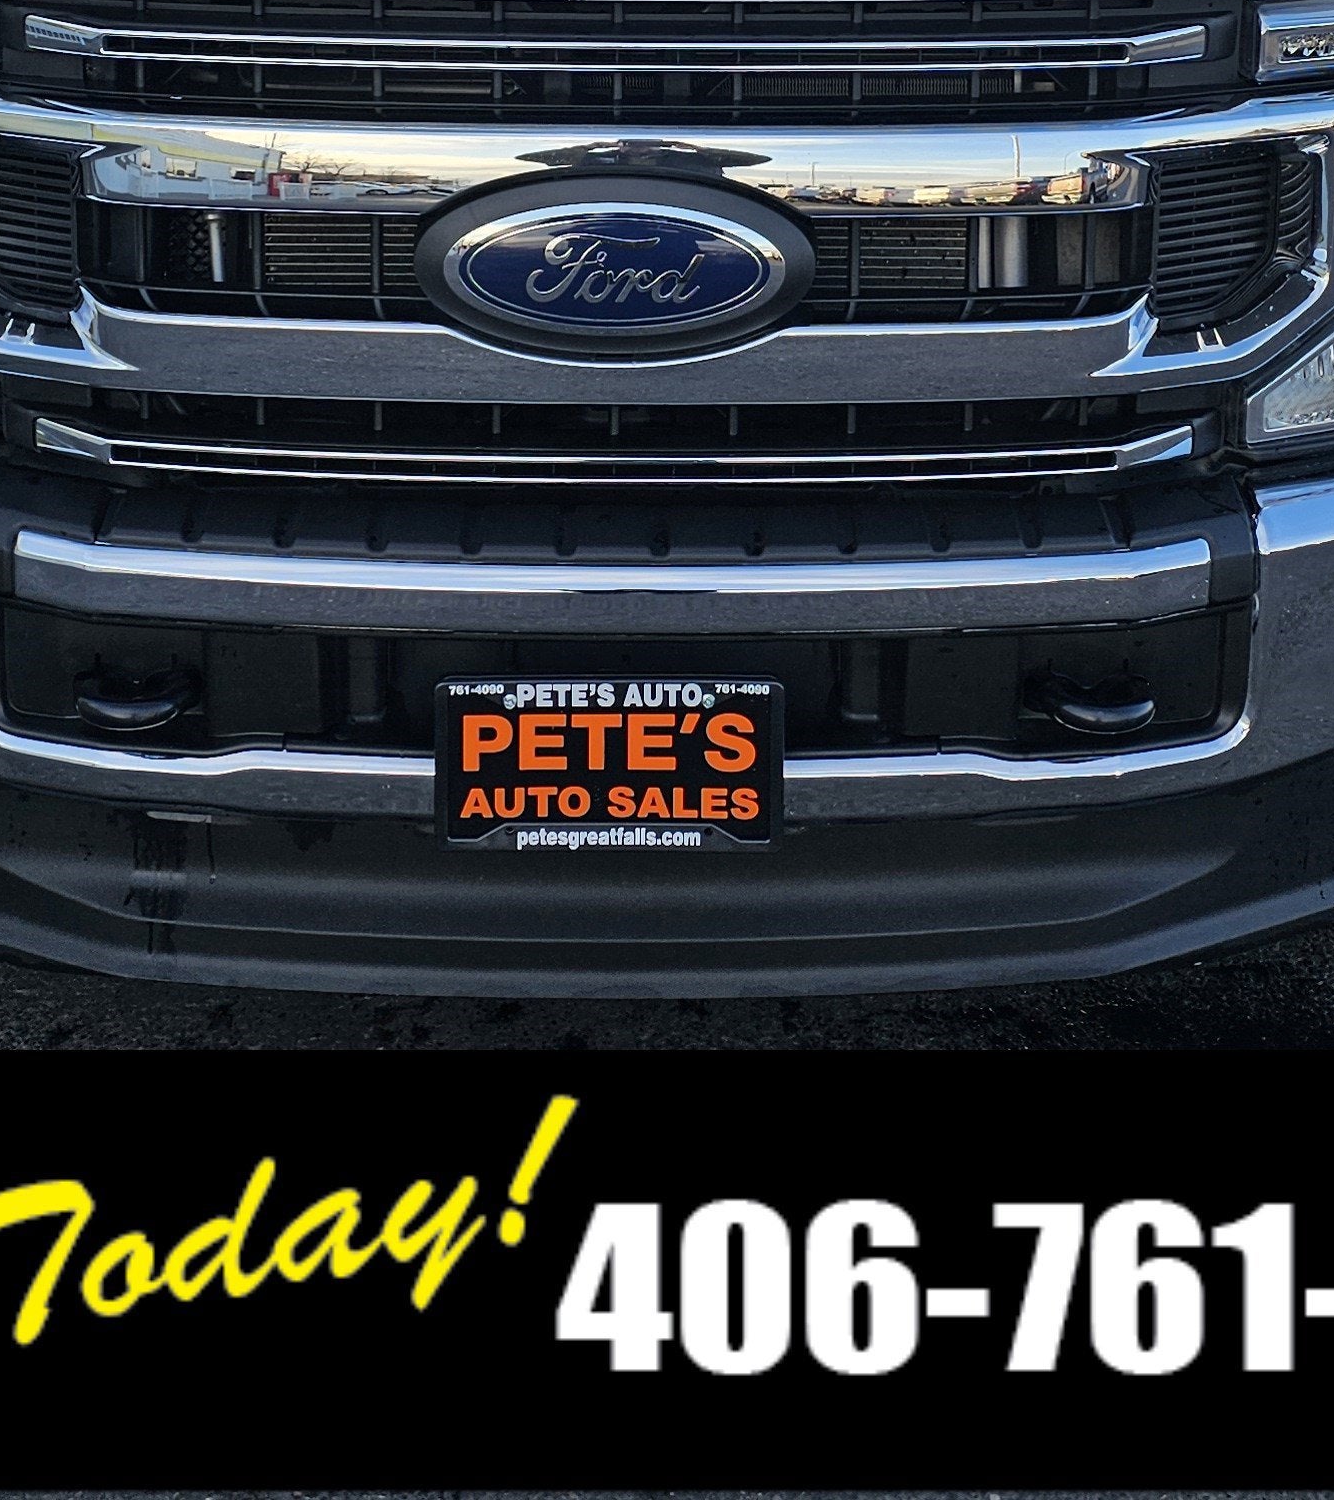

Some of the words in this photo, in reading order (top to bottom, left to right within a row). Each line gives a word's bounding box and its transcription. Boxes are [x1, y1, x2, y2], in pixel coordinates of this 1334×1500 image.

[526, 233, 704, 304] Ford
[517, 684, 615, 708] PETE'S
[624, 684, 702, 708] AUTO
[463, 713, 756, 772] PETE'S
[460, 786, 591, 819] AUTO
[608, 787, 759, 820] SALES
[517, 827, 701, 850] petesgreatfalls.com
